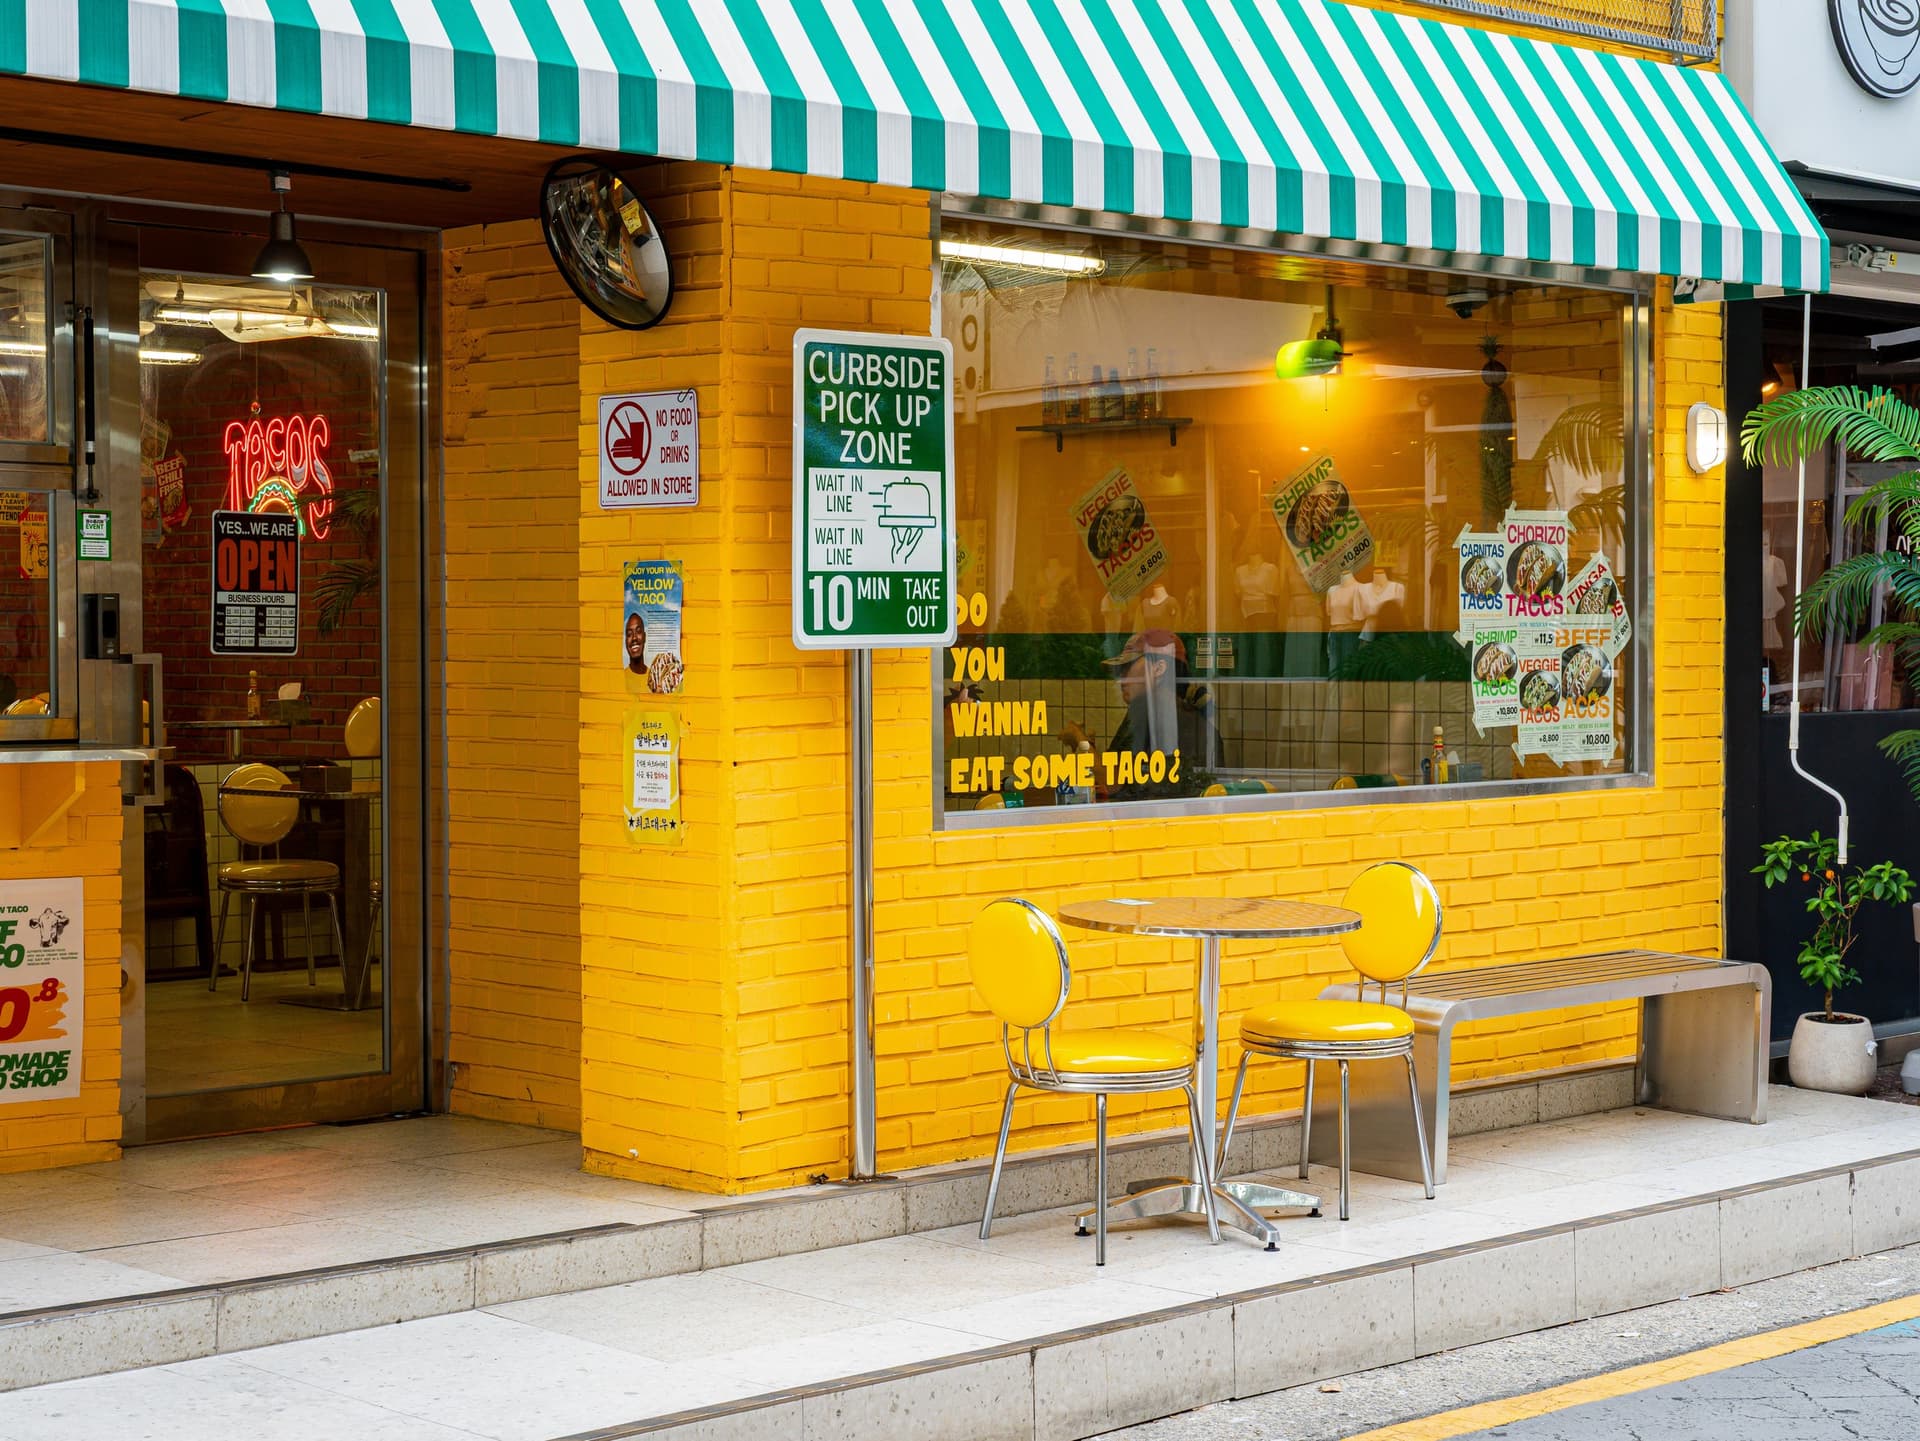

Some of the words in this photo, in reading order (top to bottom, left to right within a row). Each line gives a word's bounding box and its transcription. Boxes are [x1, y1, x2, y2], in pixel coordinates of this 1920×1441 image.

[809, 350, 941, 390] CURBSIDE
[656, 409, 668, 427] NO
[670, 407, 692, 426] FOOD
[820, 390, 882, 425] PICK
[895, 394, 931, 427] UP
[671, 430, 679, 441] OR
[660, 445, 690, 463] DRINKS
[839, 430, 912, 464] ZONE
[155, 456, 183, 475] BEEF
[157, 468, 183, 487] CHILI
[225, 415, 333, 540] TACOS
[607, 479, 648, 496] ALLOWED
[651, 478, 660, 495] IN
[663, 477, 692, 494] STORE
[815, 474, 845, 492] WAIT
[851, 475, 863, 492] IN
[1274, 458, 1333, 516] SHRIMP
[159, 480, 184, 498] FRIES
[826, 495, 852, 512] LINE
[1076, 473, 1132, 528] VEGGIE
[271, 523, 295, 536] ARE
[815, 528, 845, 544] WAIT
[851, 528, 863, 544] IN
[1296, 510, 1360, 567] TACOS
[1507, 524, 1566, 545] CHORIZO
[826, 548, 852, 565] LINE
[1097, 522, 1154, 578] TACOS
[1461, 543, 1504, 558] CARNITAS
[217, 538, 296, 592] OPEN
[627, 567, 645, 575] ENJOY
[646, 567, 664, 575] YOUR
[665, 566, 680, 574] WAY
[630, 578, 675, 590] YELLOW
[1567, 563, 1608, 605] TINGA
[228, 594, 261, 603] BUSINESS
[262, 594, 285, 604] HOURS
[638, 592, 666, 605] TACO
[809, 574, 853, 631] 10
[857, 577, 890, 600] MIN
[903, 578, 941, 600] TAKE
[1461, 593, 1503, 610] TACOS
[1506, 594, 1564, 616] TACOS
[906, 605, 938, 628] OUT
[1475, 630, 1518, 646] SHRIMP
[1554, 629, 1612, 647] BEEF
[950, 647, 1005, 682] YOU
[1519, 658, 1560, 673] VEGGIE
[1473, 679, 1518, 697] TACOS
[1519, 706, 1560, 724] TACOS
[1563, 695, 1611, 719] ACOS
[951, 700, 1048, 737] WANNA
[951, 756, 1005, 793] EAT
[1013, 753, 1095, 790] SOME
[7, 905, 29, 913] TACO
[9, 1068, 68, 1090] SHOP
